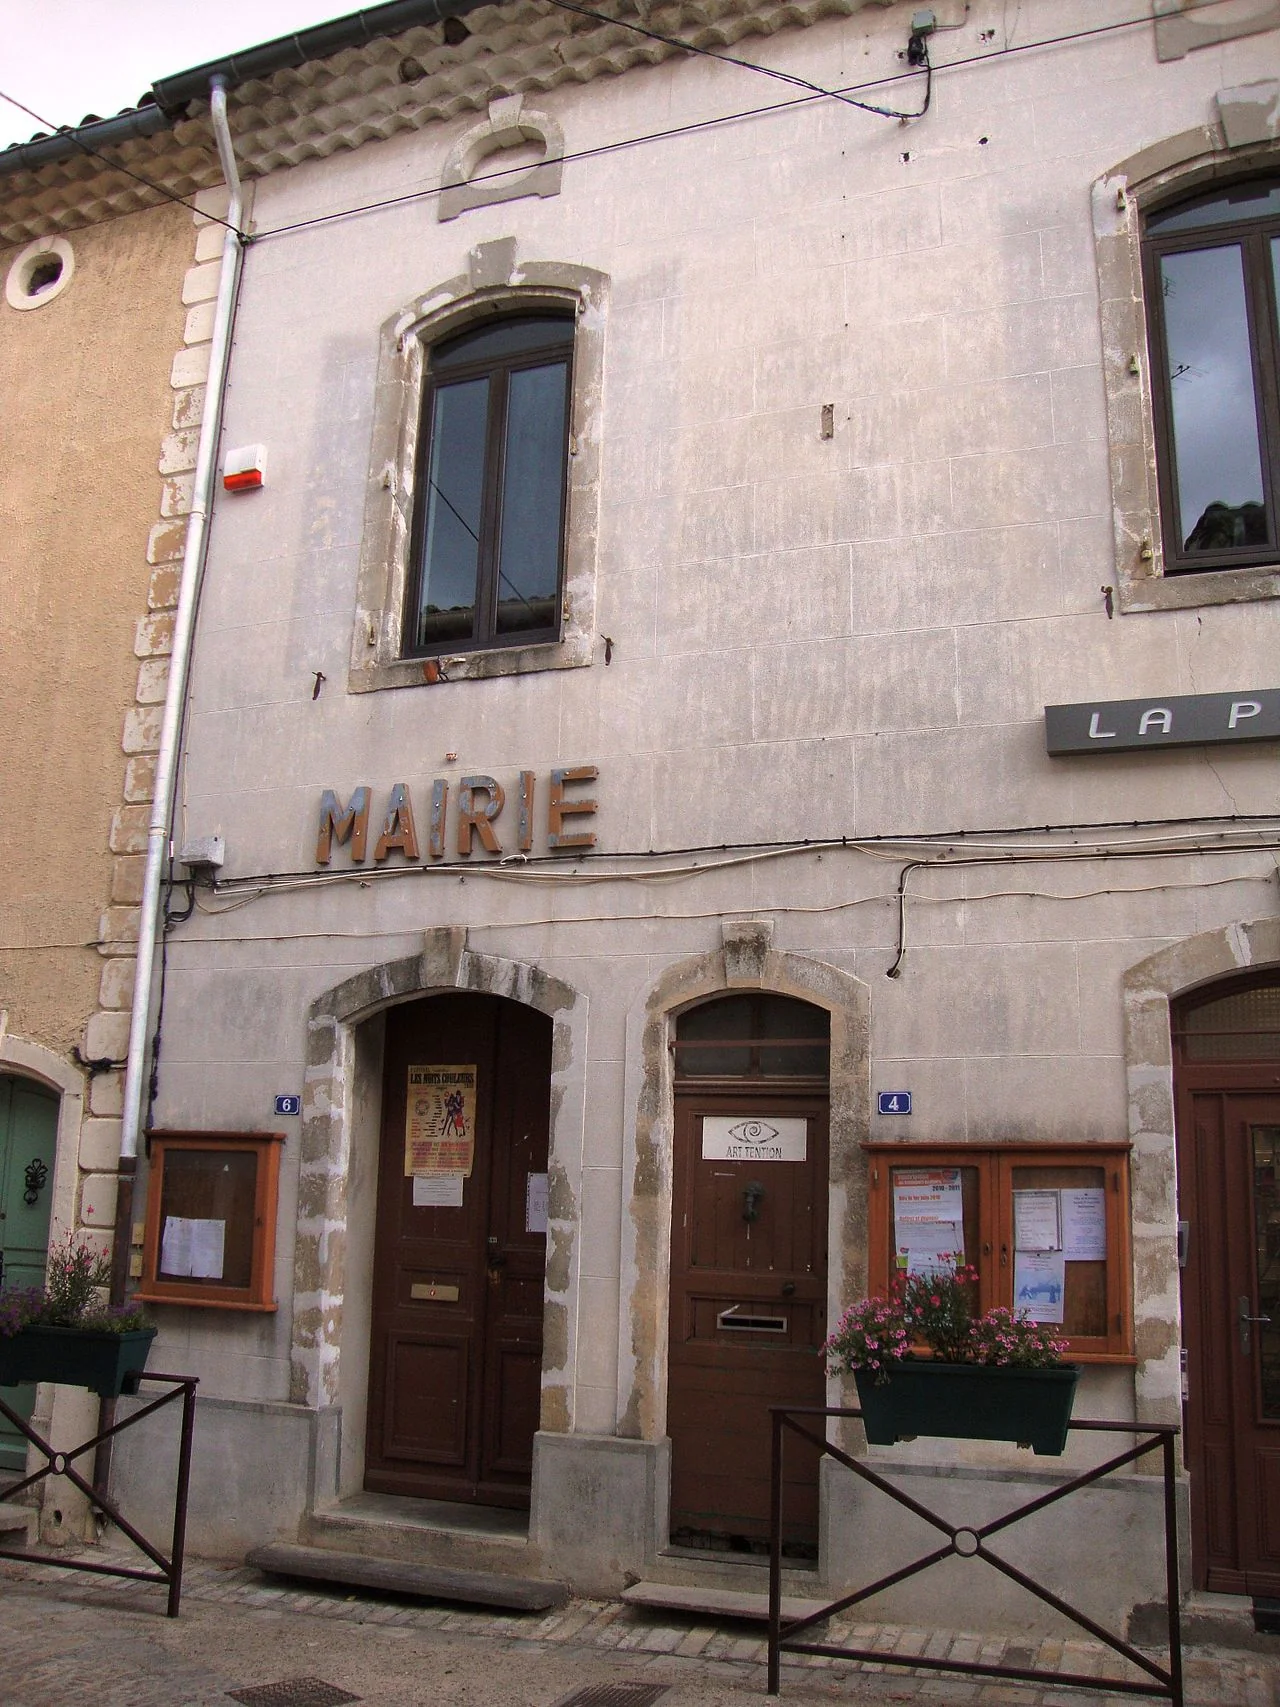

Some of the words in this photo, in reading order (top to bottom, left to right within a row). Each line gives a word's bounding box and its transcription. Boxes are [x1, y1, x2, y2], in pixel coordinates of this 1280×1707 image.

[1088, 707, 1172, 738] LA
[316, 766, 599, 864] MAIRIE
[410, 1073, 422, 1084] LES
[423, 1073, 441, 1084] NUITS
[442, 1072, 474, 1084] COULEURS
[282, 1098, 291, 1111] 6
[888, 1096, 899, 1111] 4
[726, 1146, 743, 1158] ART
[744, 1146, 783, 1159] TENTION
